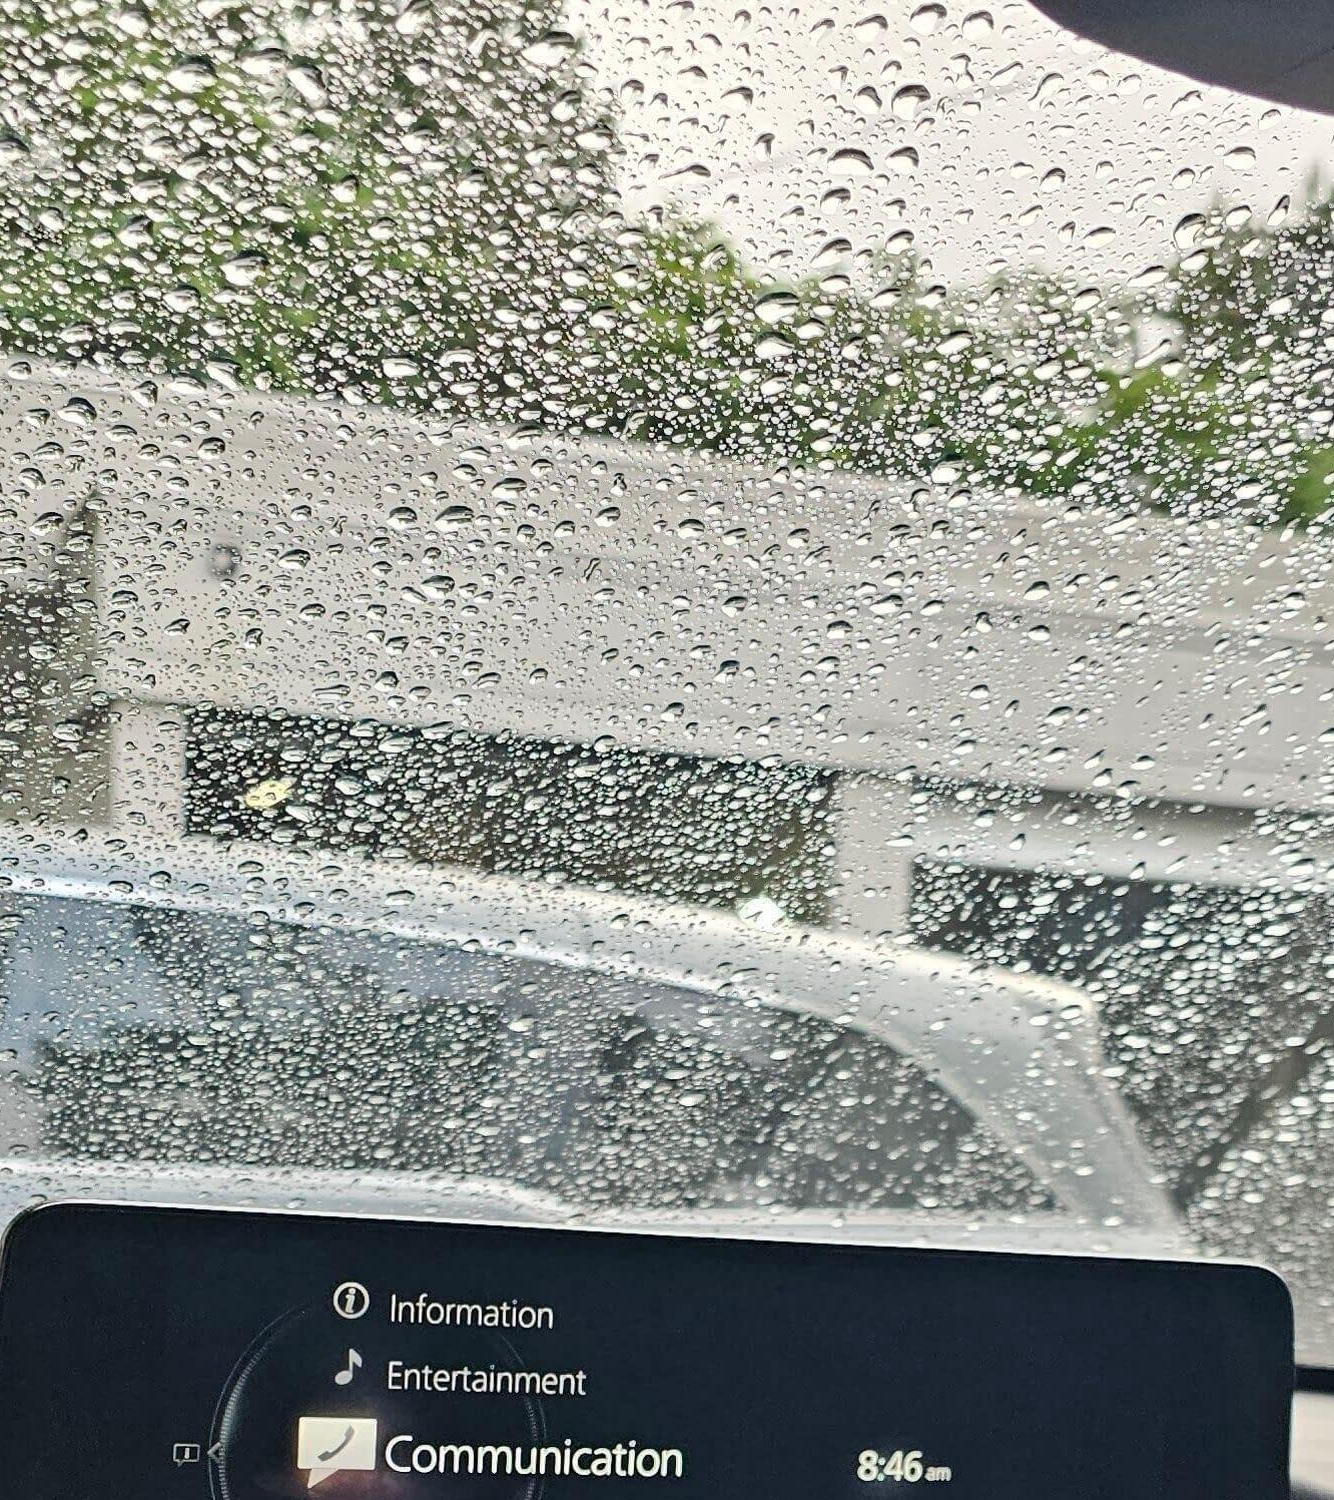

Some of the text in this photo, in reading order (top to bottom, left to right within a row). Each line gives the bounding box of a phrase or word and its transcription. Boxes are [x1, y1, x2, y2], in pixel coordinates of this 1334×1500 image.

[389, 1292, 555, 1329] Information
[386, 1360, 587, 1396] Entertainment
[384, 1434, 684, 1478] Communication
